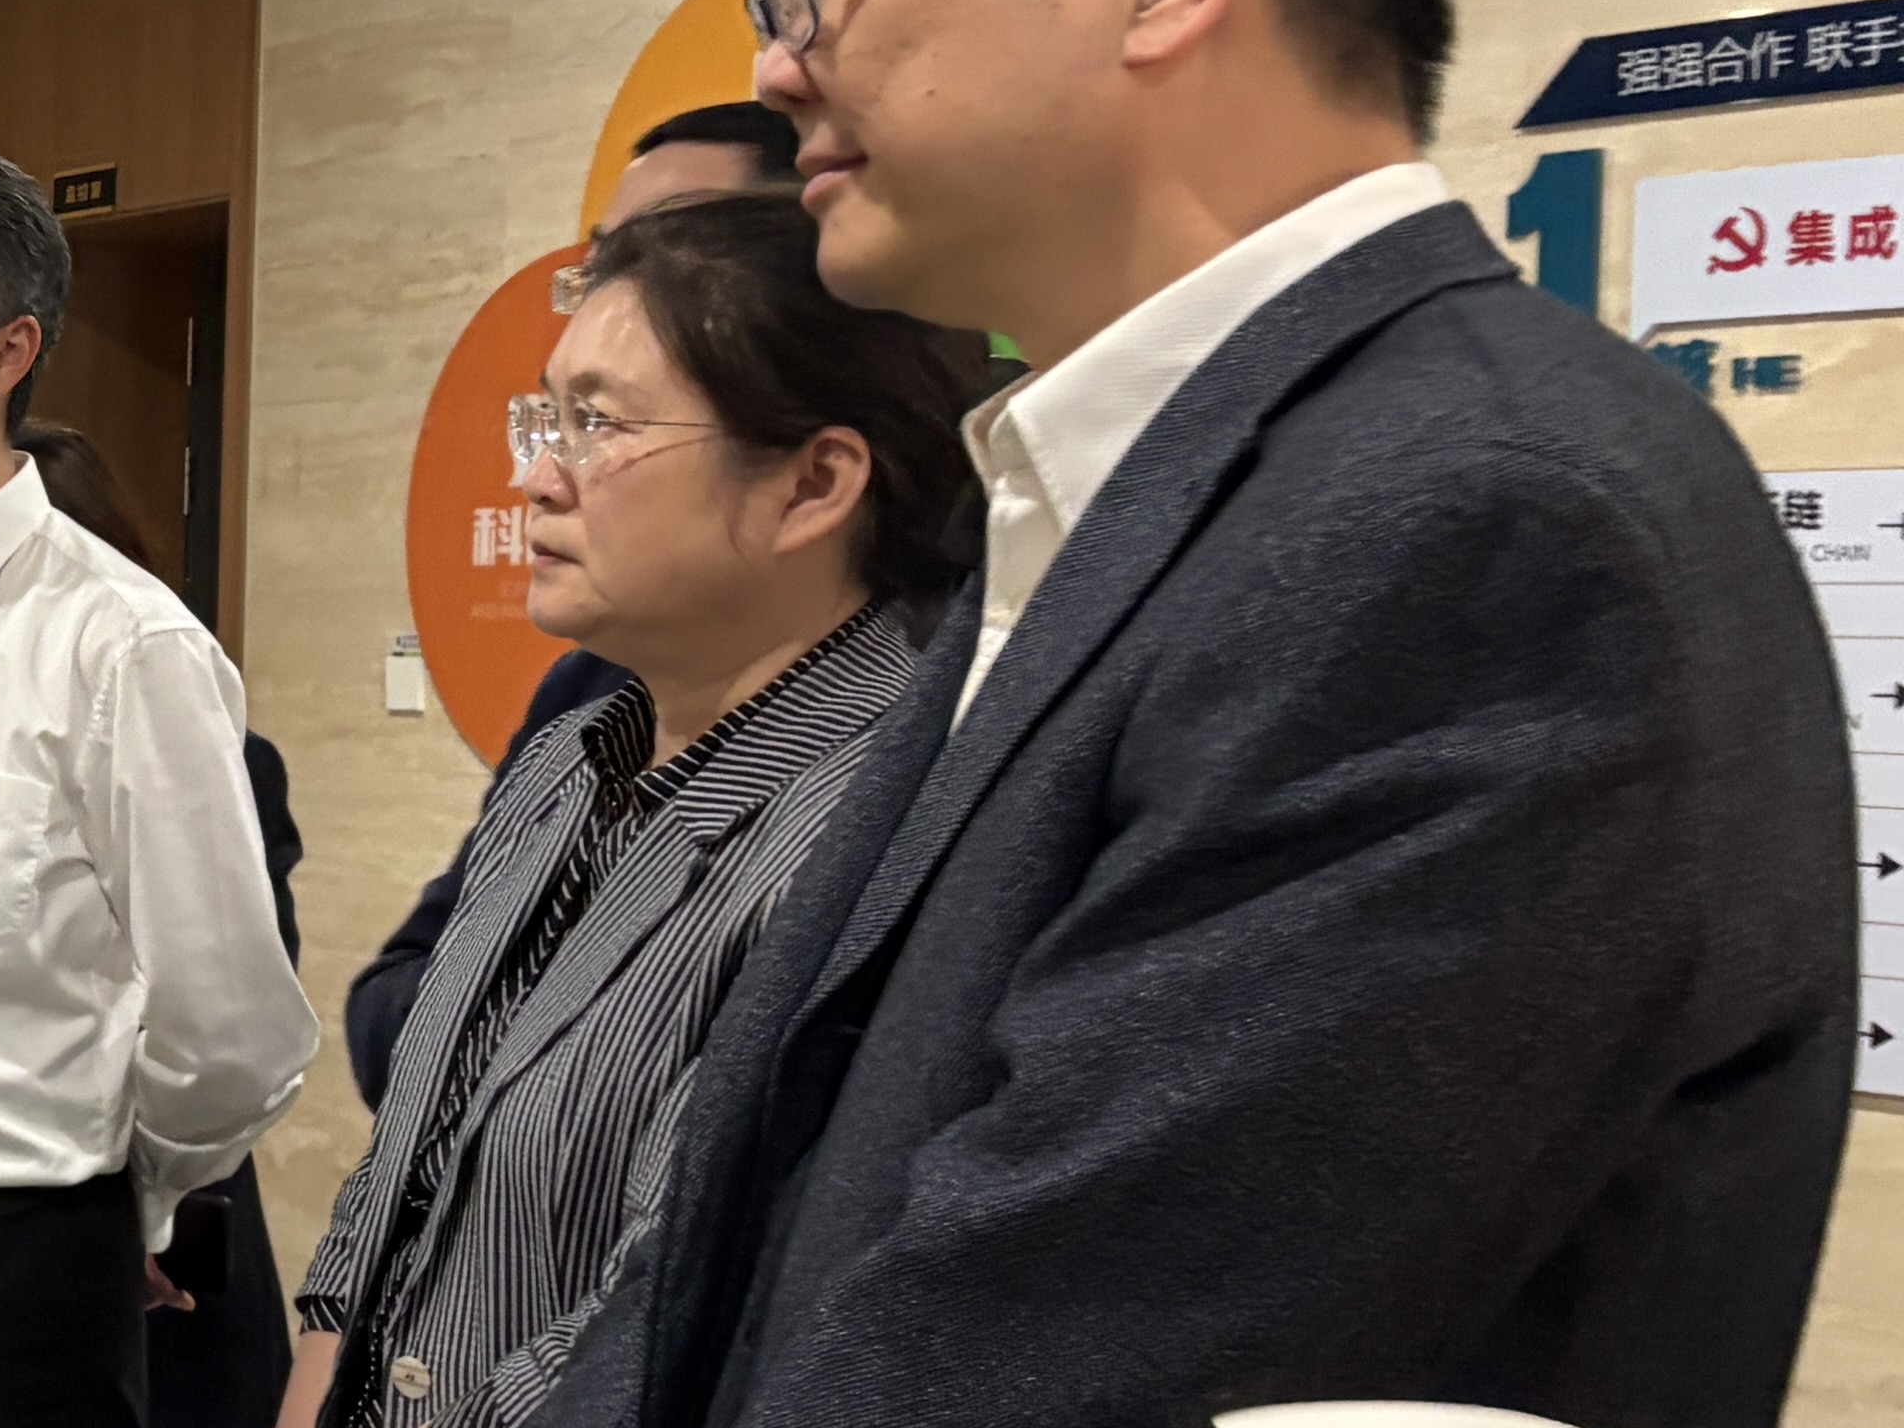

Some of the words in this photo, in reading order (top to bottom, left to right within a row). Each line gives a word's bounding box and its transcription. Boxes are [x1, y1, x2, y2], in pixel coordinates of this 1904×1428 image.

[1618, 31, 1795, 97] 强强合作
[1803, 15, 1904, 72] 联手
[1505, 148, 1604, 324] 1
[1784, 204, 1898, 266] 集成
[472, 507, 534, 568] 科
